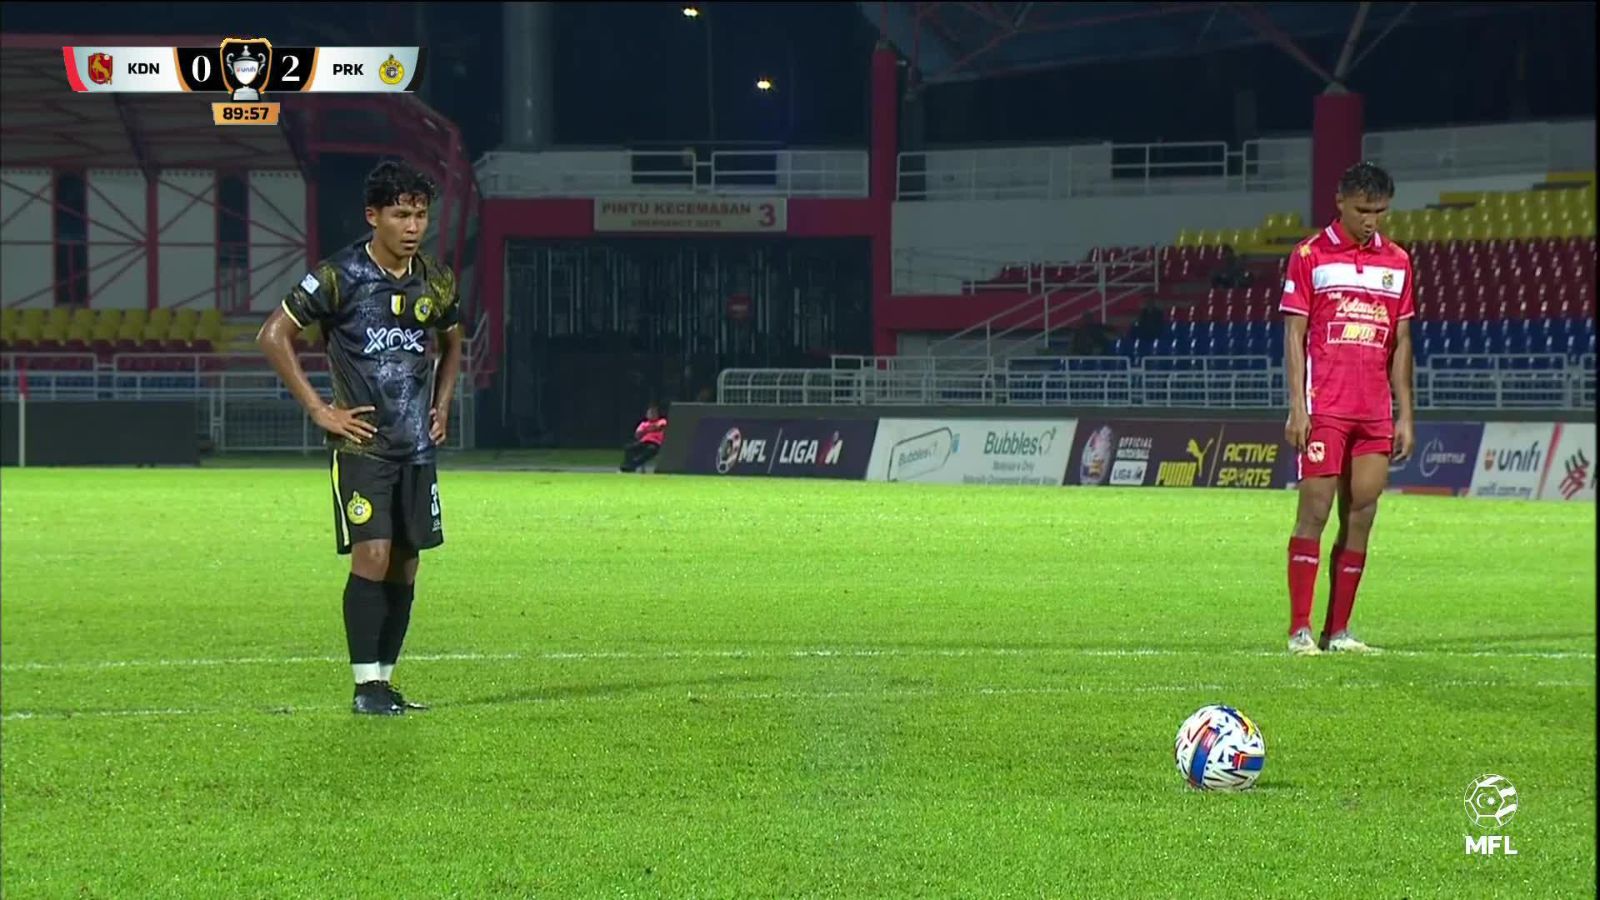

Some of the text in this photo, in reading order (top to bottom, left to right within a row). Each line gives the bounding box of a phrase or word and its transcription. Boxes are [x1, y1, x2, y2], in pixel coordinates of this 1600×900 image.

[602, 202, 776, 227] PINTU KECEMASAN 3
[364, 327, 425, 352] XOX
[738, 439, 767, 463] MFL
[779, 439, 819, 464] LIGA
[984, 431, 1039, 455] Bubbles
[1223, 443, 1279, 462] ACTIVE
[1498, 440, 1542, 472] unifi
[1155, 461, 1197, 486] PUMA
[1217, 468, 1272, 487] SPORTS
